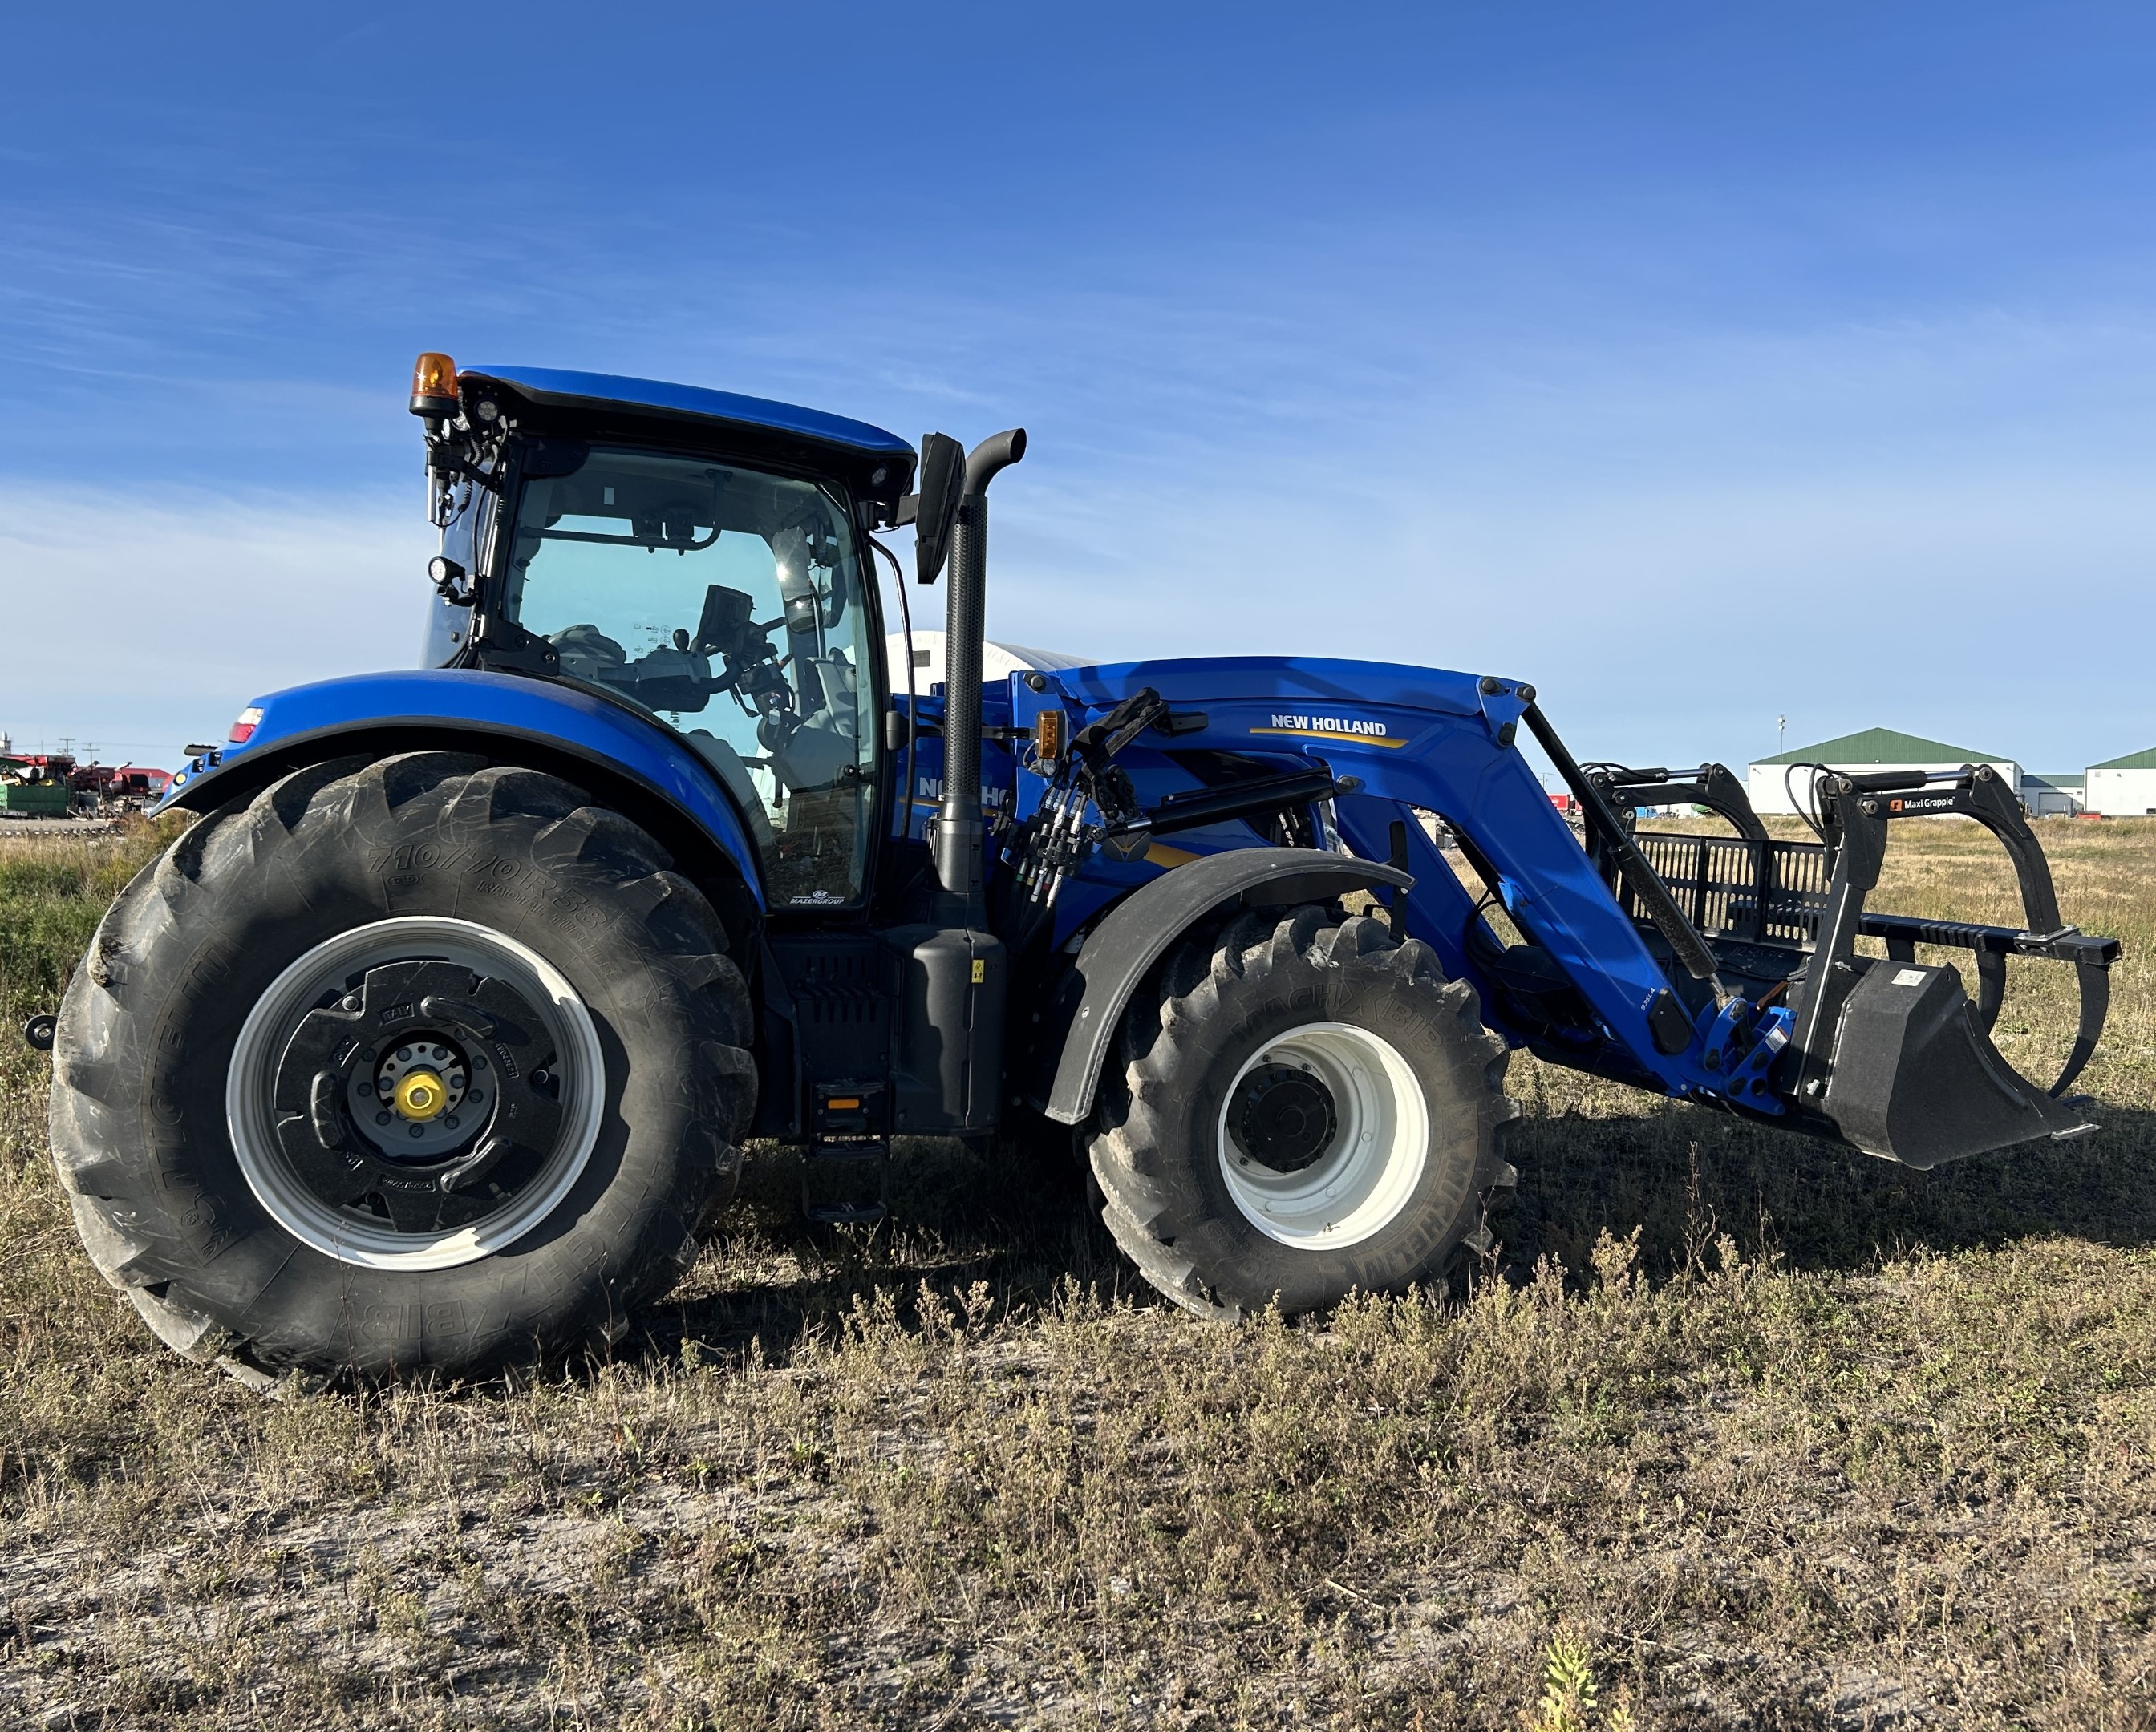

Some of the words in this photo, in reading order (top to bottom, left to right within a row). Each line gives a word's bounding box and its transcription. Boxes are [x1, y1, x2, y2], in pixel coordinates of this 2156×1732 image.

[1271, 714, 1309, 729] NEW
[1312, 717, 1387, 736] HOLLAND
[1905, 799, 1923, 809] Maxi
[476, 880, 546, 917] RADIAL
[383, 1005, 411, 1020] ITALY
